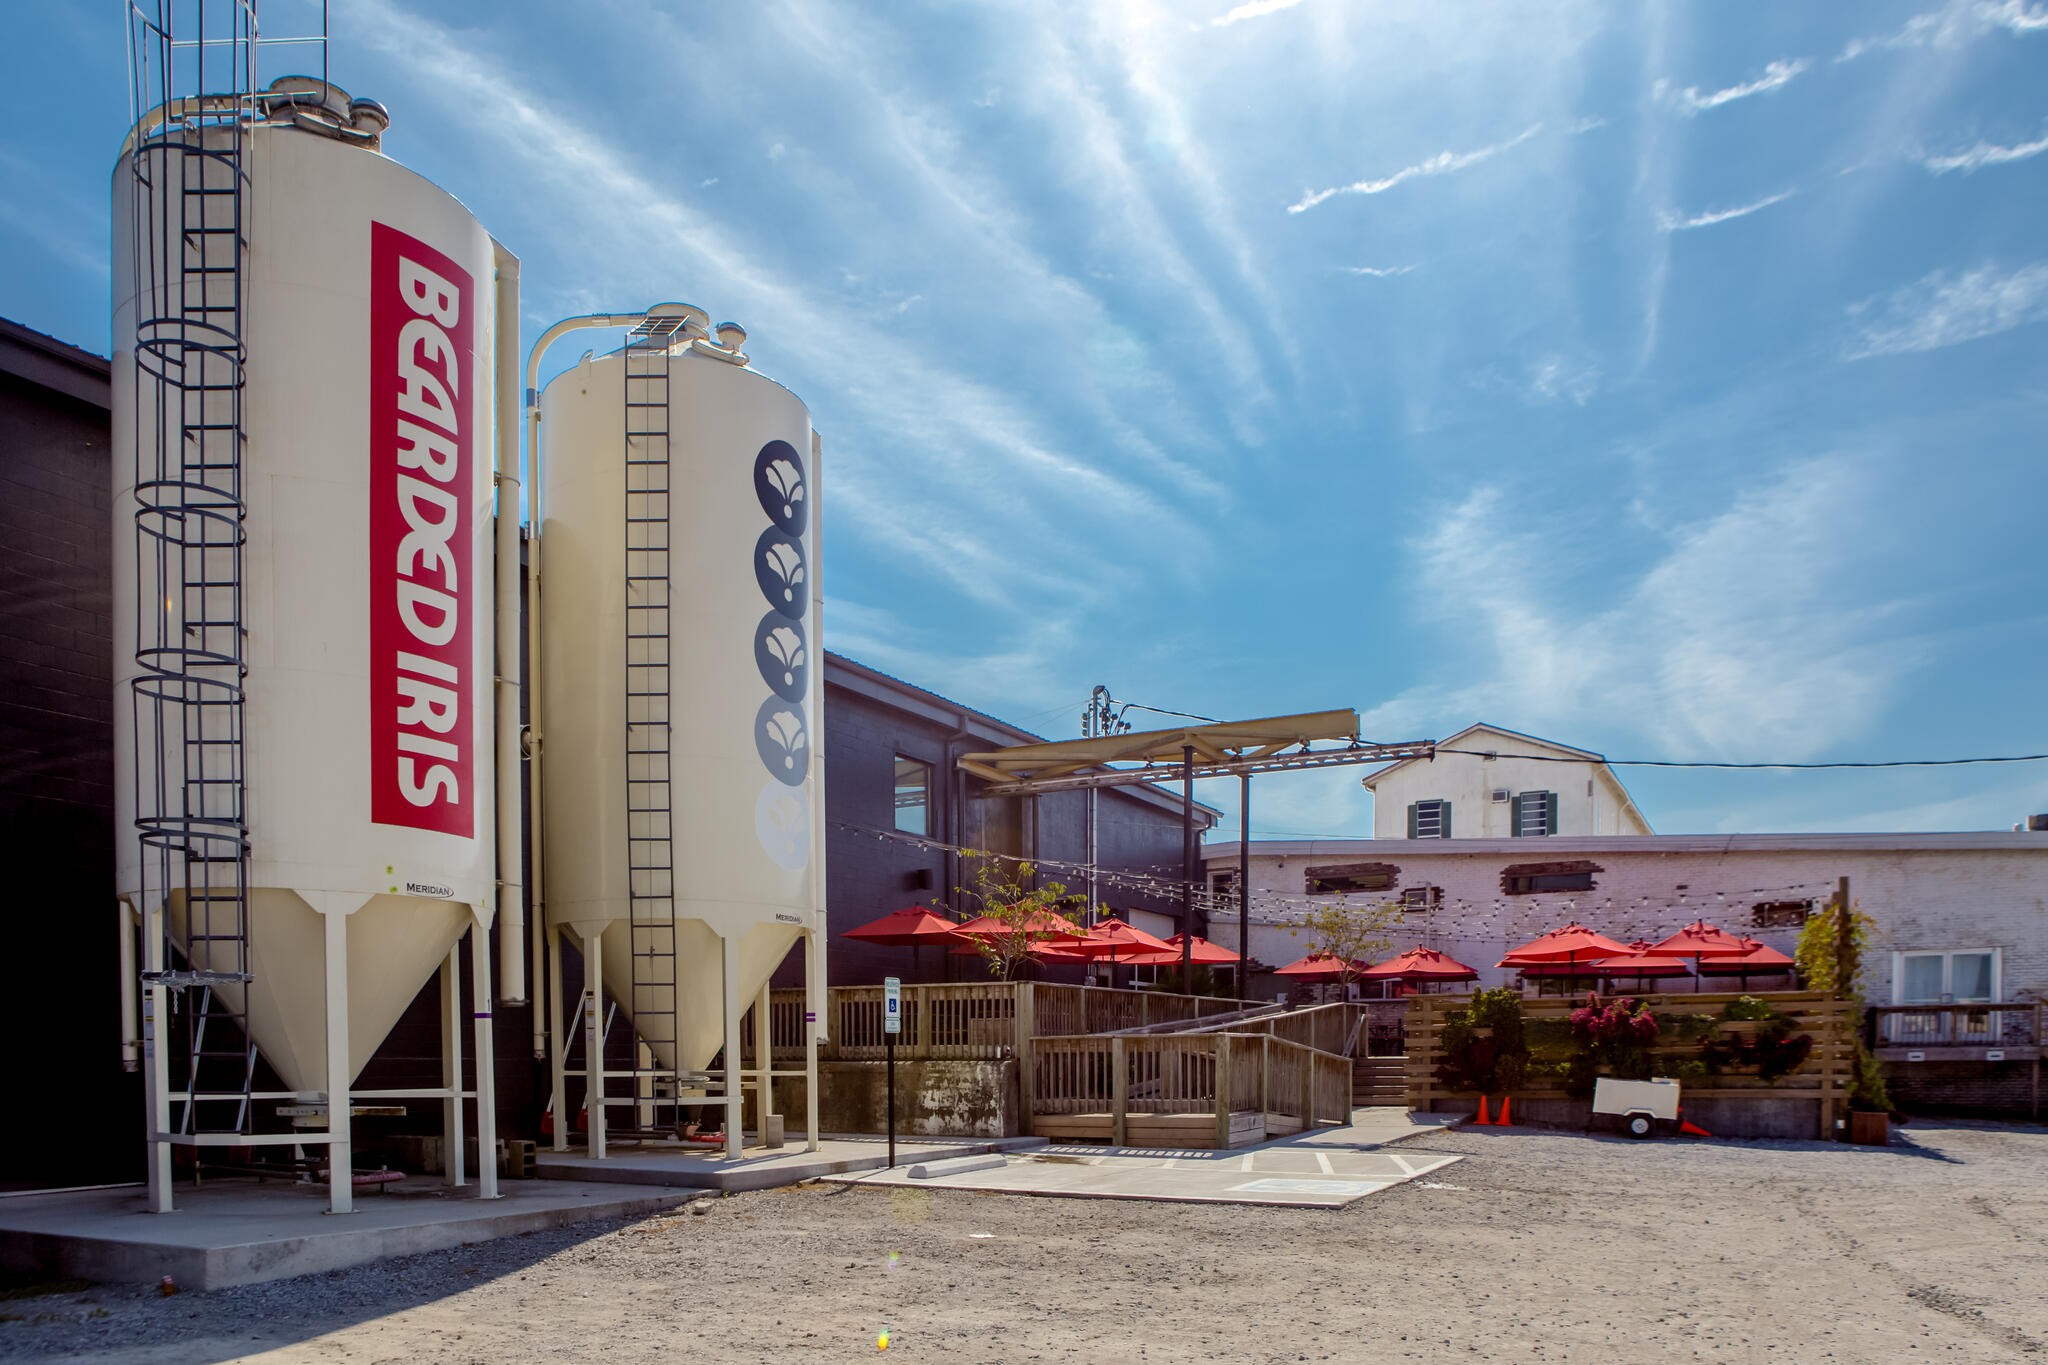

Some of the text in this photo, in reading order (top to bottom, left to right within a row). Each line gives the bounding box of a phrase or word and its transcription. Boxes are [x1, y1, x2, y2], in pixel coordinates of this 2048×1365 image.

[397, 255, 460, 808] BEARDED IRIS
[406, 882, 450, 896] MERIDIAN
